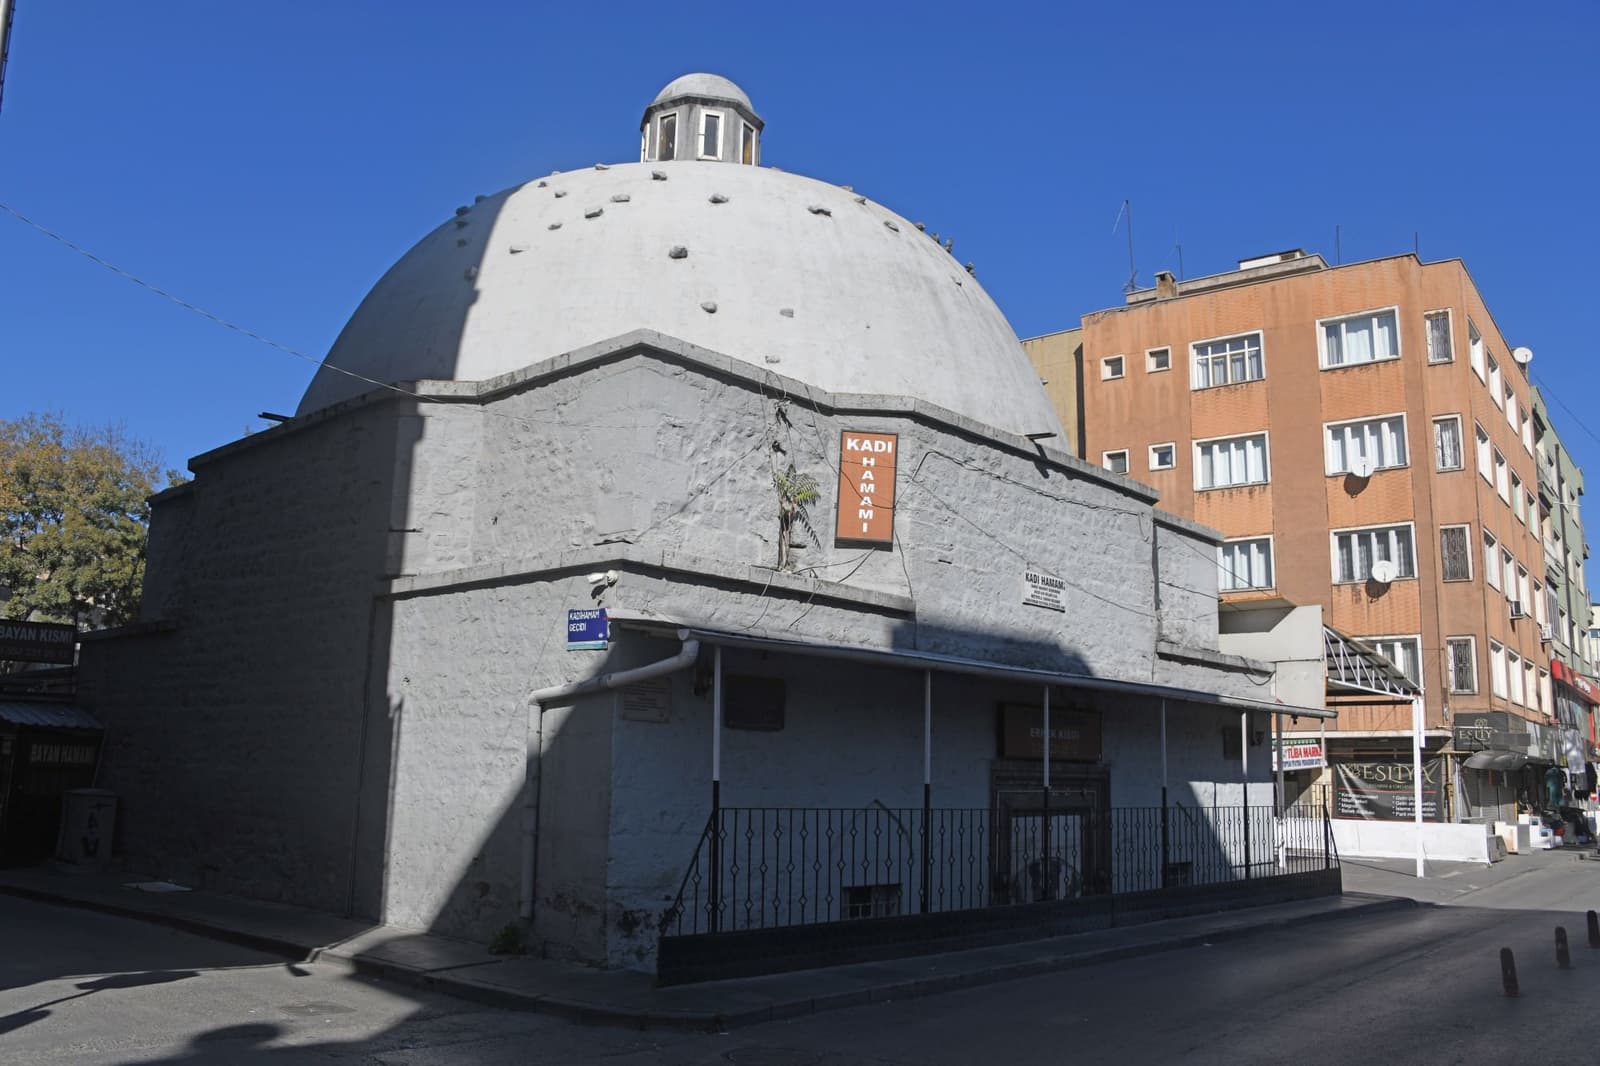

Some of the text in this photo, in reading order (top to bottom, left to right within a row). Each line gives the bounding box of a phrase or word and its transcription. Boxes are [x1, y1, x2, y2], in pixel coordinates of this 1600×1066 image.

[846, 438, 892, 453] KADI
[858, 456, 875, 533] HAMAMI
[1025, 572, 1039, 585] KADI
